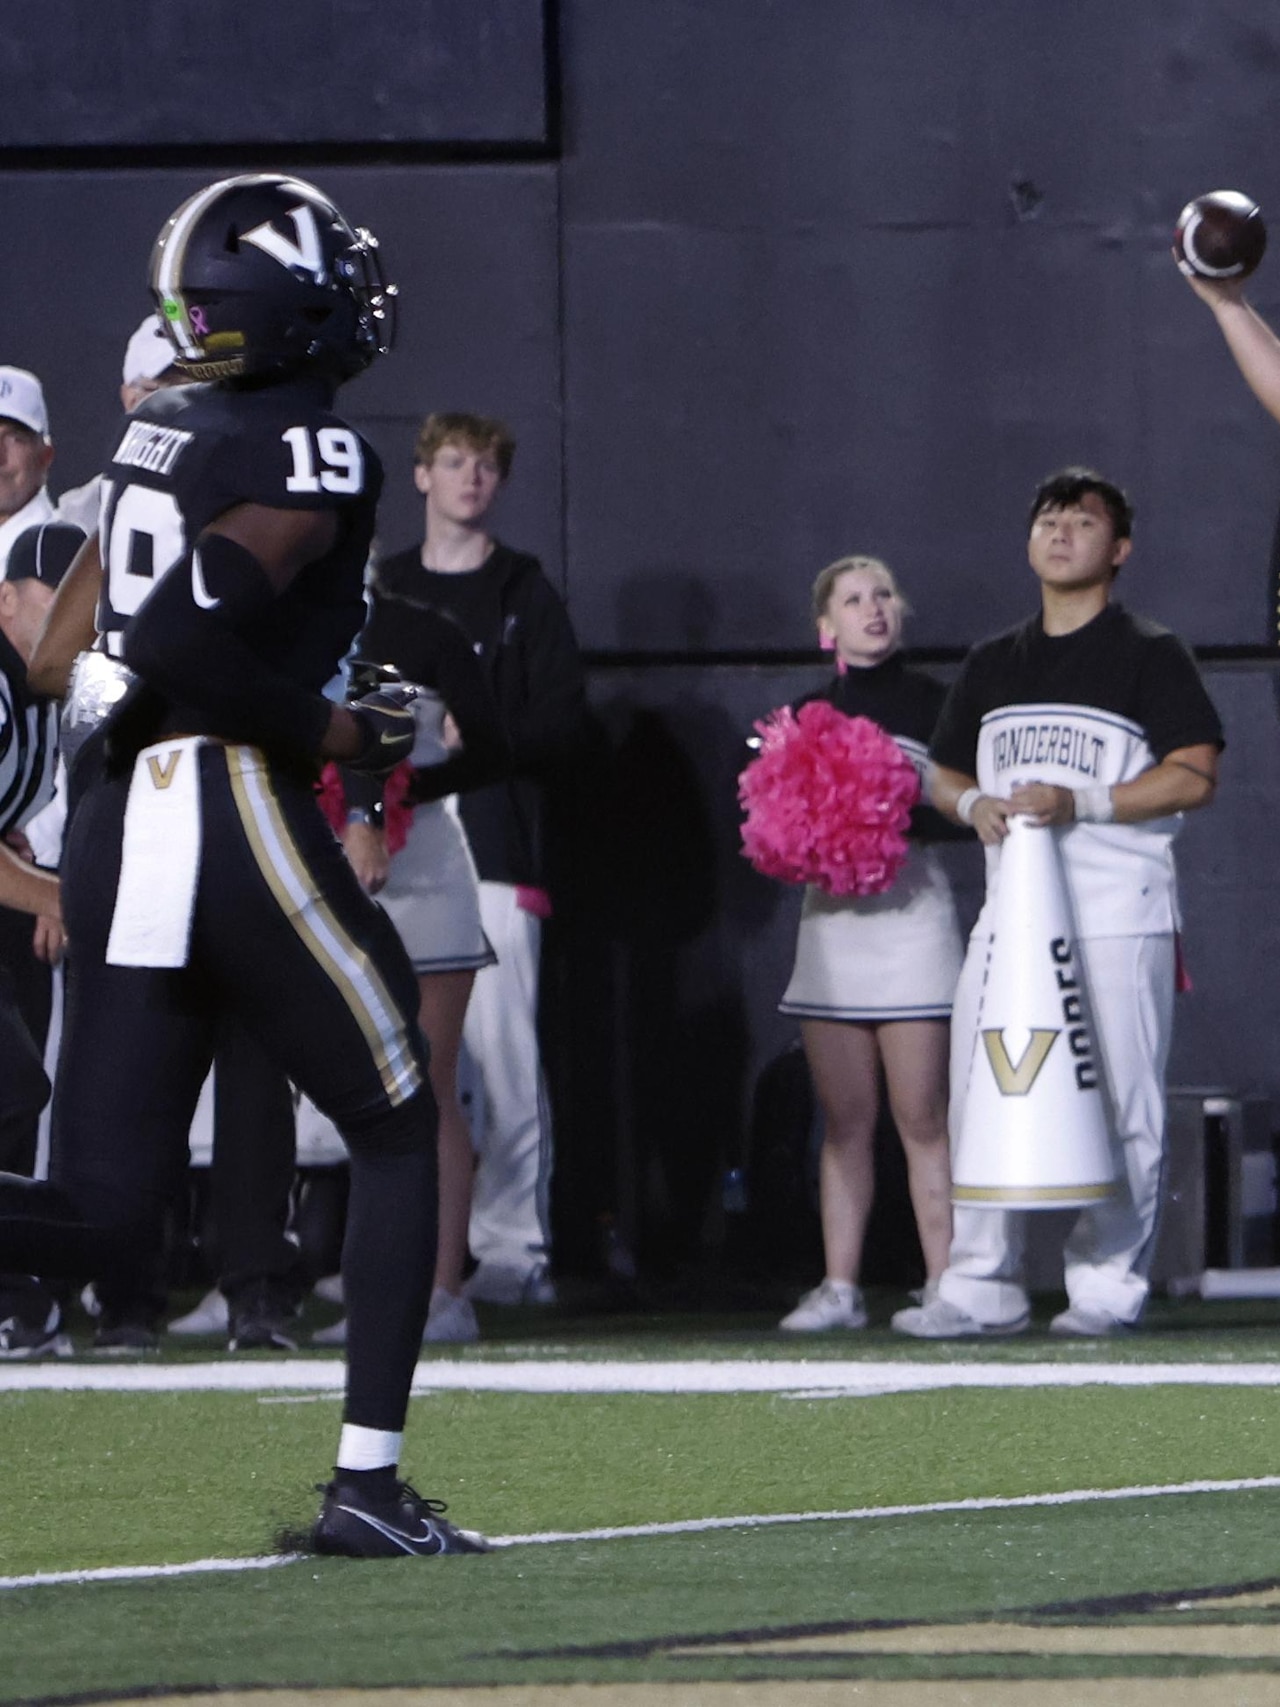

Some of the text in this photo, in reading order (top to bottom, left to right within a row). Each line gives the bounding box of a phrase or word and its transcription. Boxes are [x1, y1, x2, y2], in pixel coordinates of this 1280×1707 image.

[281, 426, 364, 494] 19
[146, 749, 183, 790] V
[982, 1027, 1062, 1096] V
